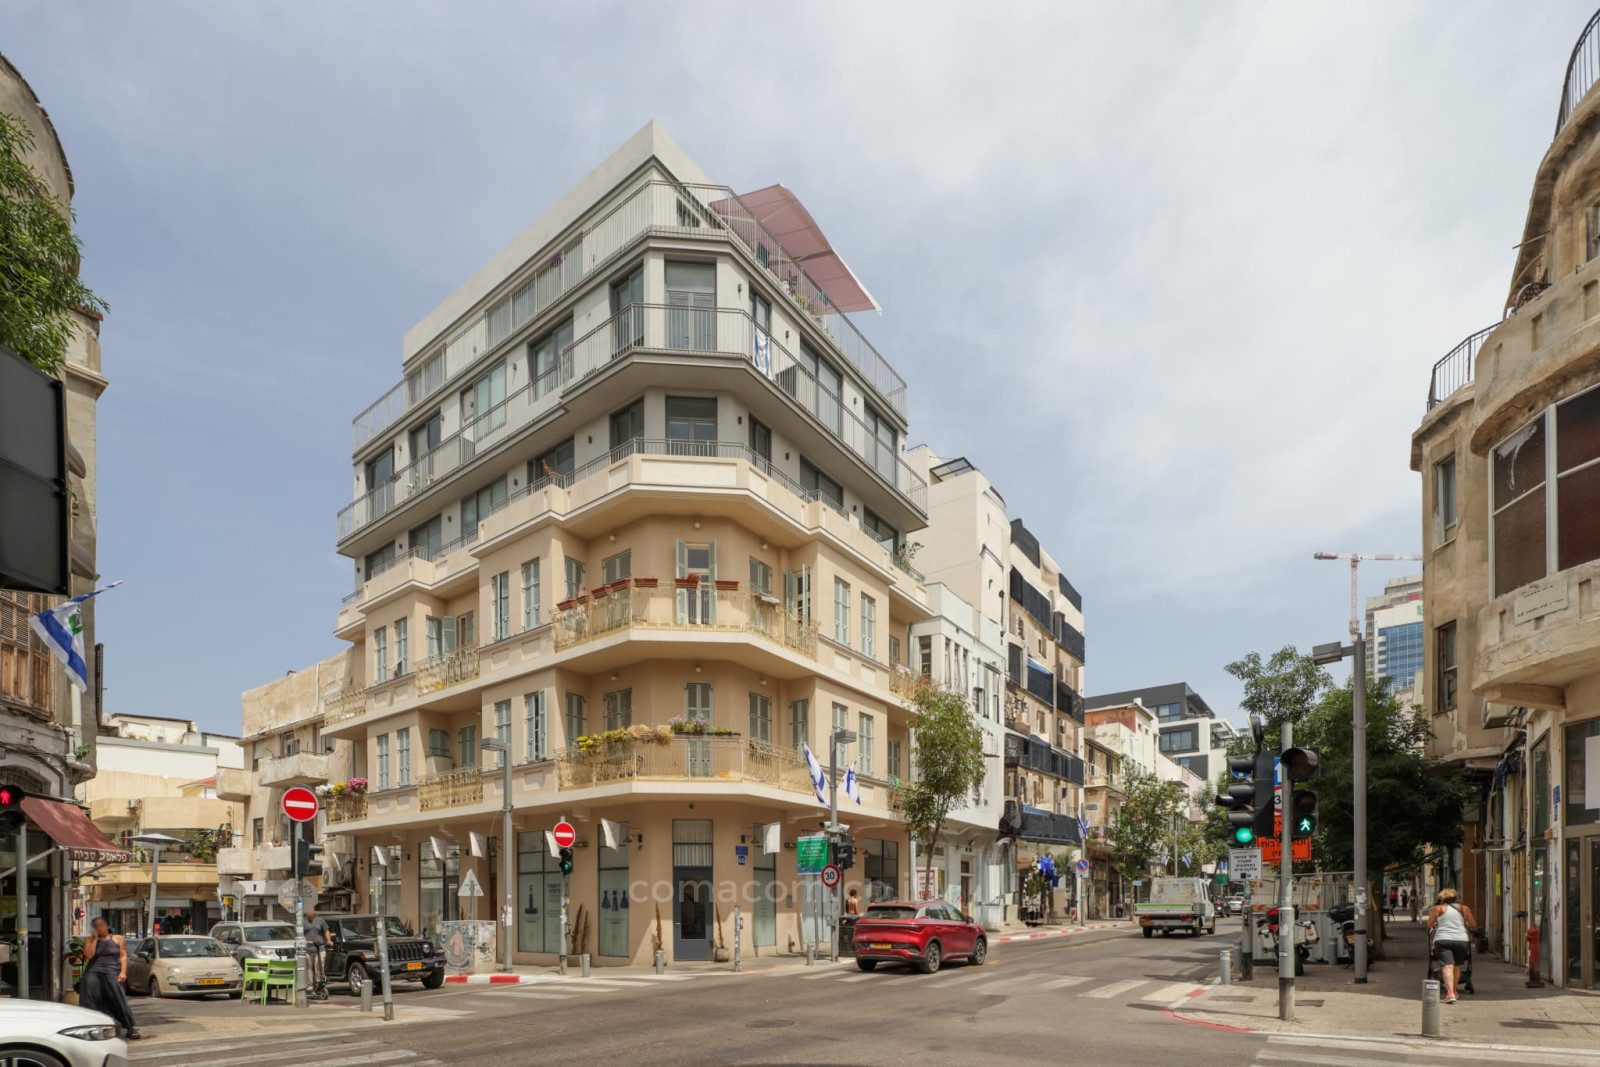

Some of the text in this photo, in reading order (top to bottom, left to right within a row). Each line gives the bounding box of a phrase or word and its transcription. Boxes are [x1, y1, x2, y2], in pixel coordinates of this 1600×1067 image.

[74, 849, 127, 862] פלאפל סביח
[824, 871, 835, 881] 30
